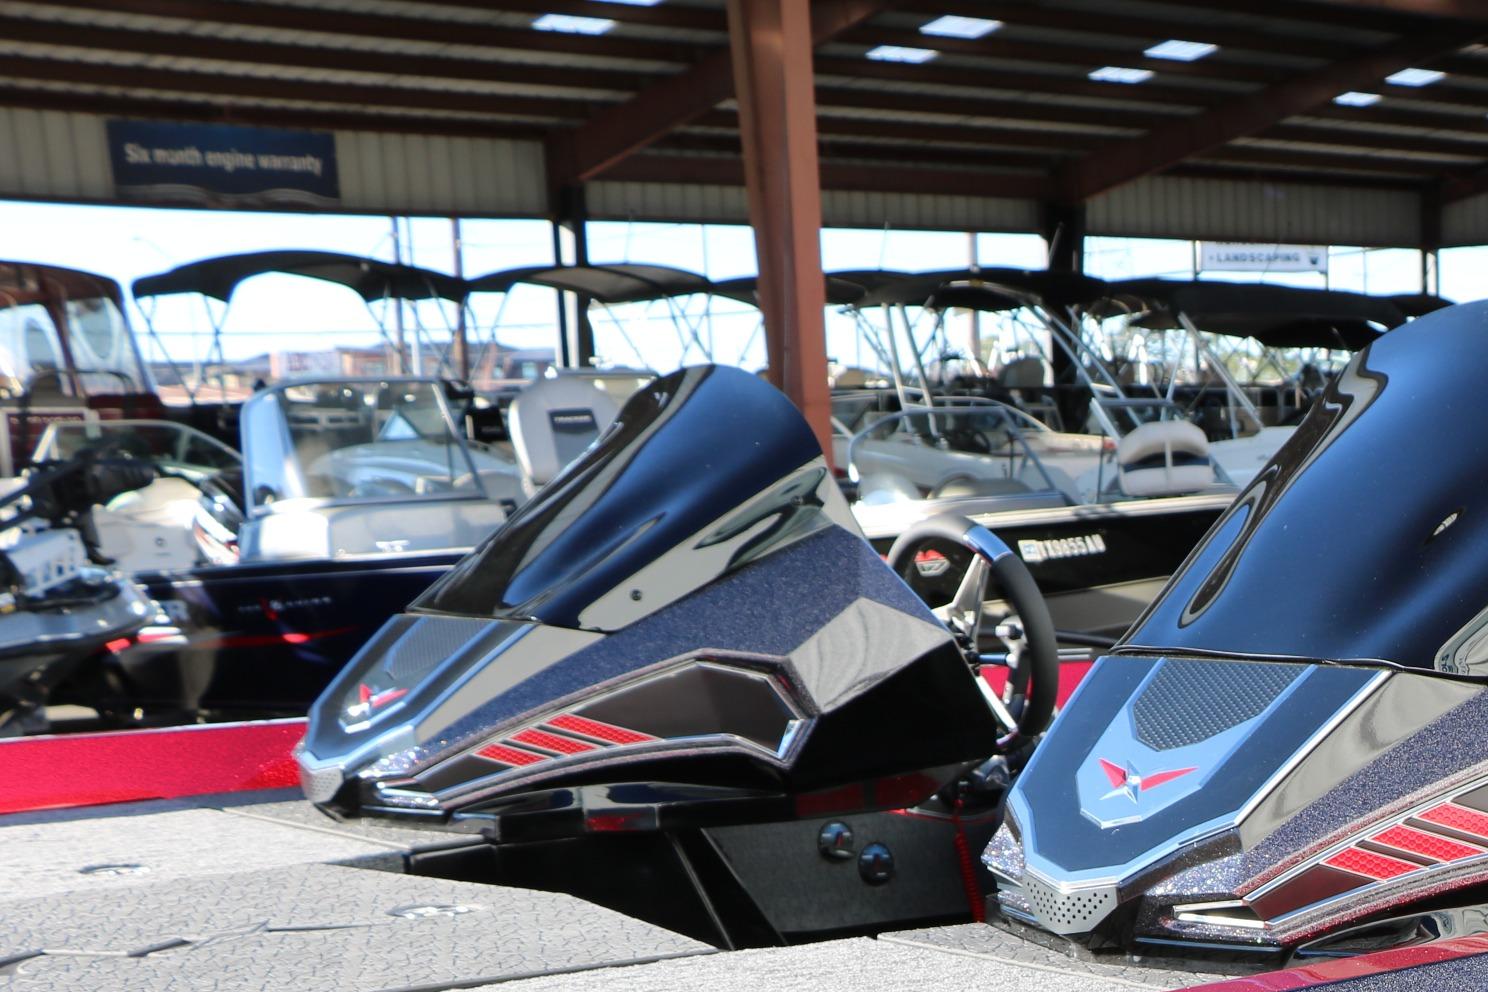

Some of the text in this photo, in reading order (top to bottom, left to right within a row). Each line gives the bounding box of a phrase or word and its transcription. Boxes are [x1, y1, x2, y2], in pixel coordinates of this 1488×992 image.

[124, 142, 322, 176] Six month engine warranty
[1216, 252, 1300, 263] LANDSCAPING
